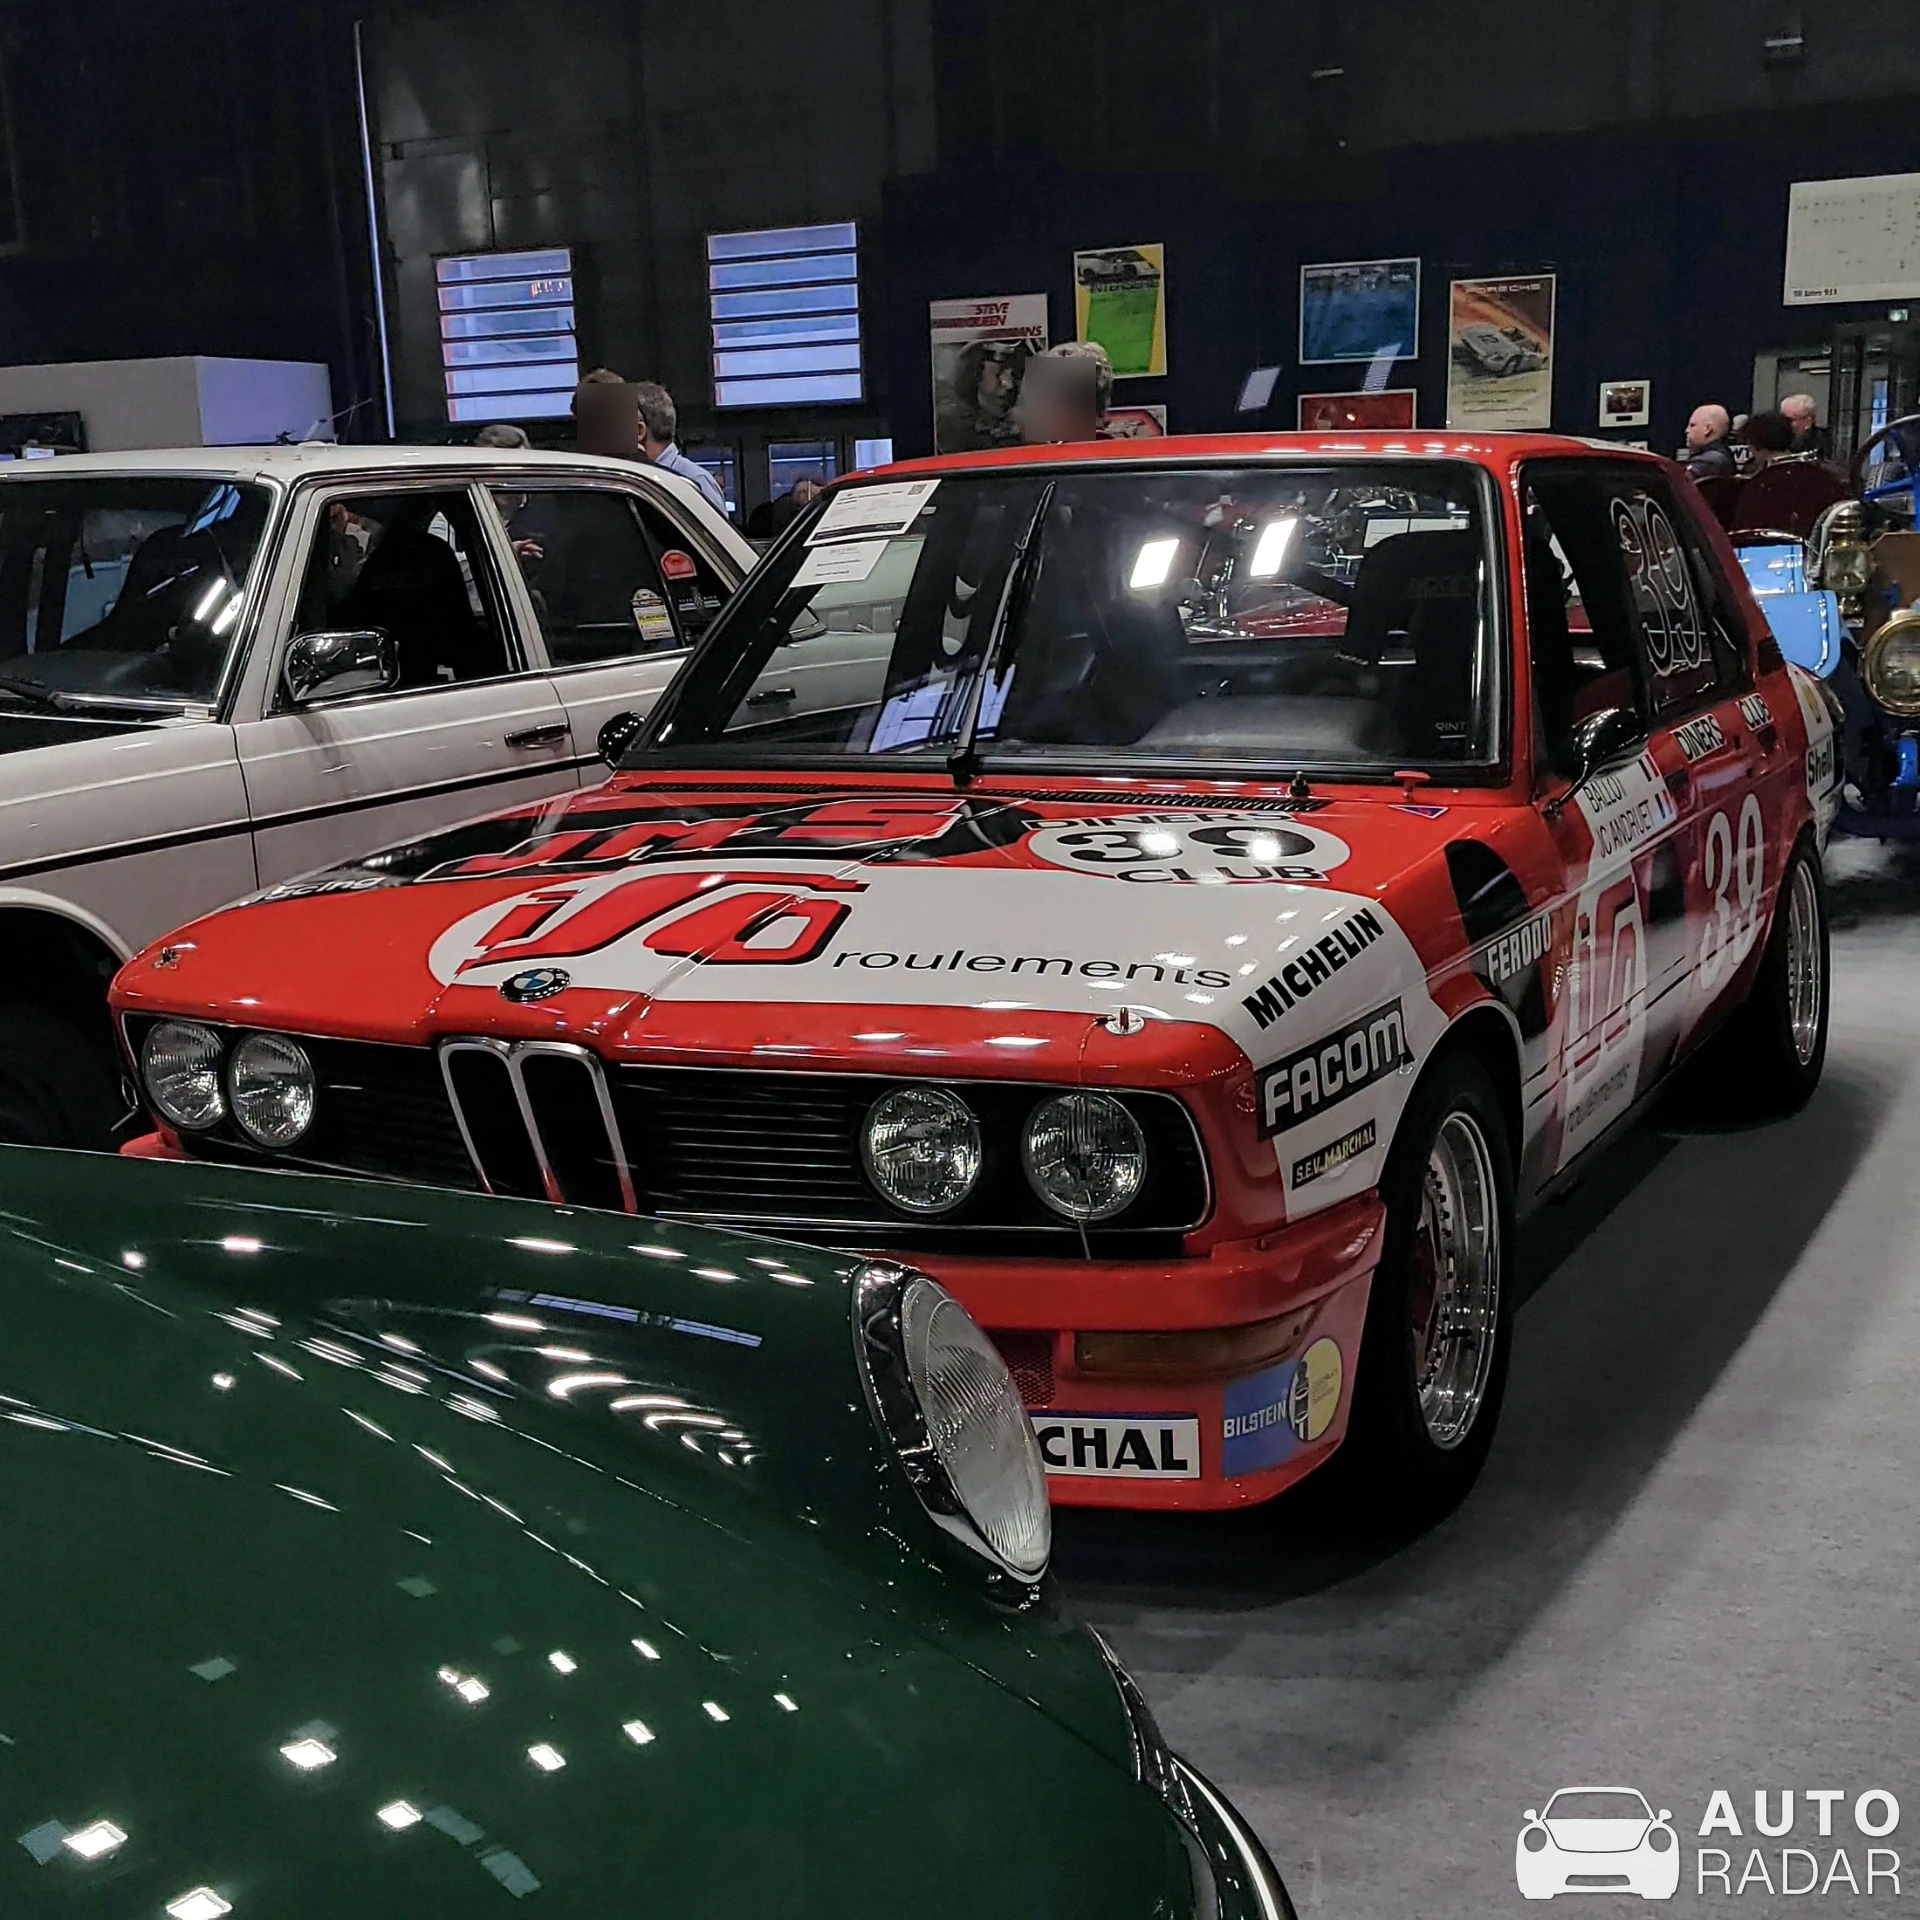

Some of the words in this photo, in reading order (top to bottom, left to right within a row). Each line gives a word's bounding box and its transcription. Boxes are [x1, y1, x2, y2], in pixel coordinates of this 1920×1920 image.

[974, 302, 1010, 315] STEVE
[1611, 498, 1702, 676] 39
[1740, 694, 1771, 728] CLUB
[1673, 715, 1725, 761] DINERS
[1808, 738, 1833, 788] Shell
[1025, 812, 1292, 830] DINERS
[1056, 826, 1316, 863] 39
[1116, 865, 1326, 883] CLUB
[1700, 793, 1765, 990] 39
[834, 949, 1231, 989] roulements
[1242, 908, 1384, 1030] MICHELIN
[1487, 911, 1552, 986] FERODO
[1264, 1010, 1405, 1127] FACOM
[1223, 1399, 1289, 1439] BILSTEIN
